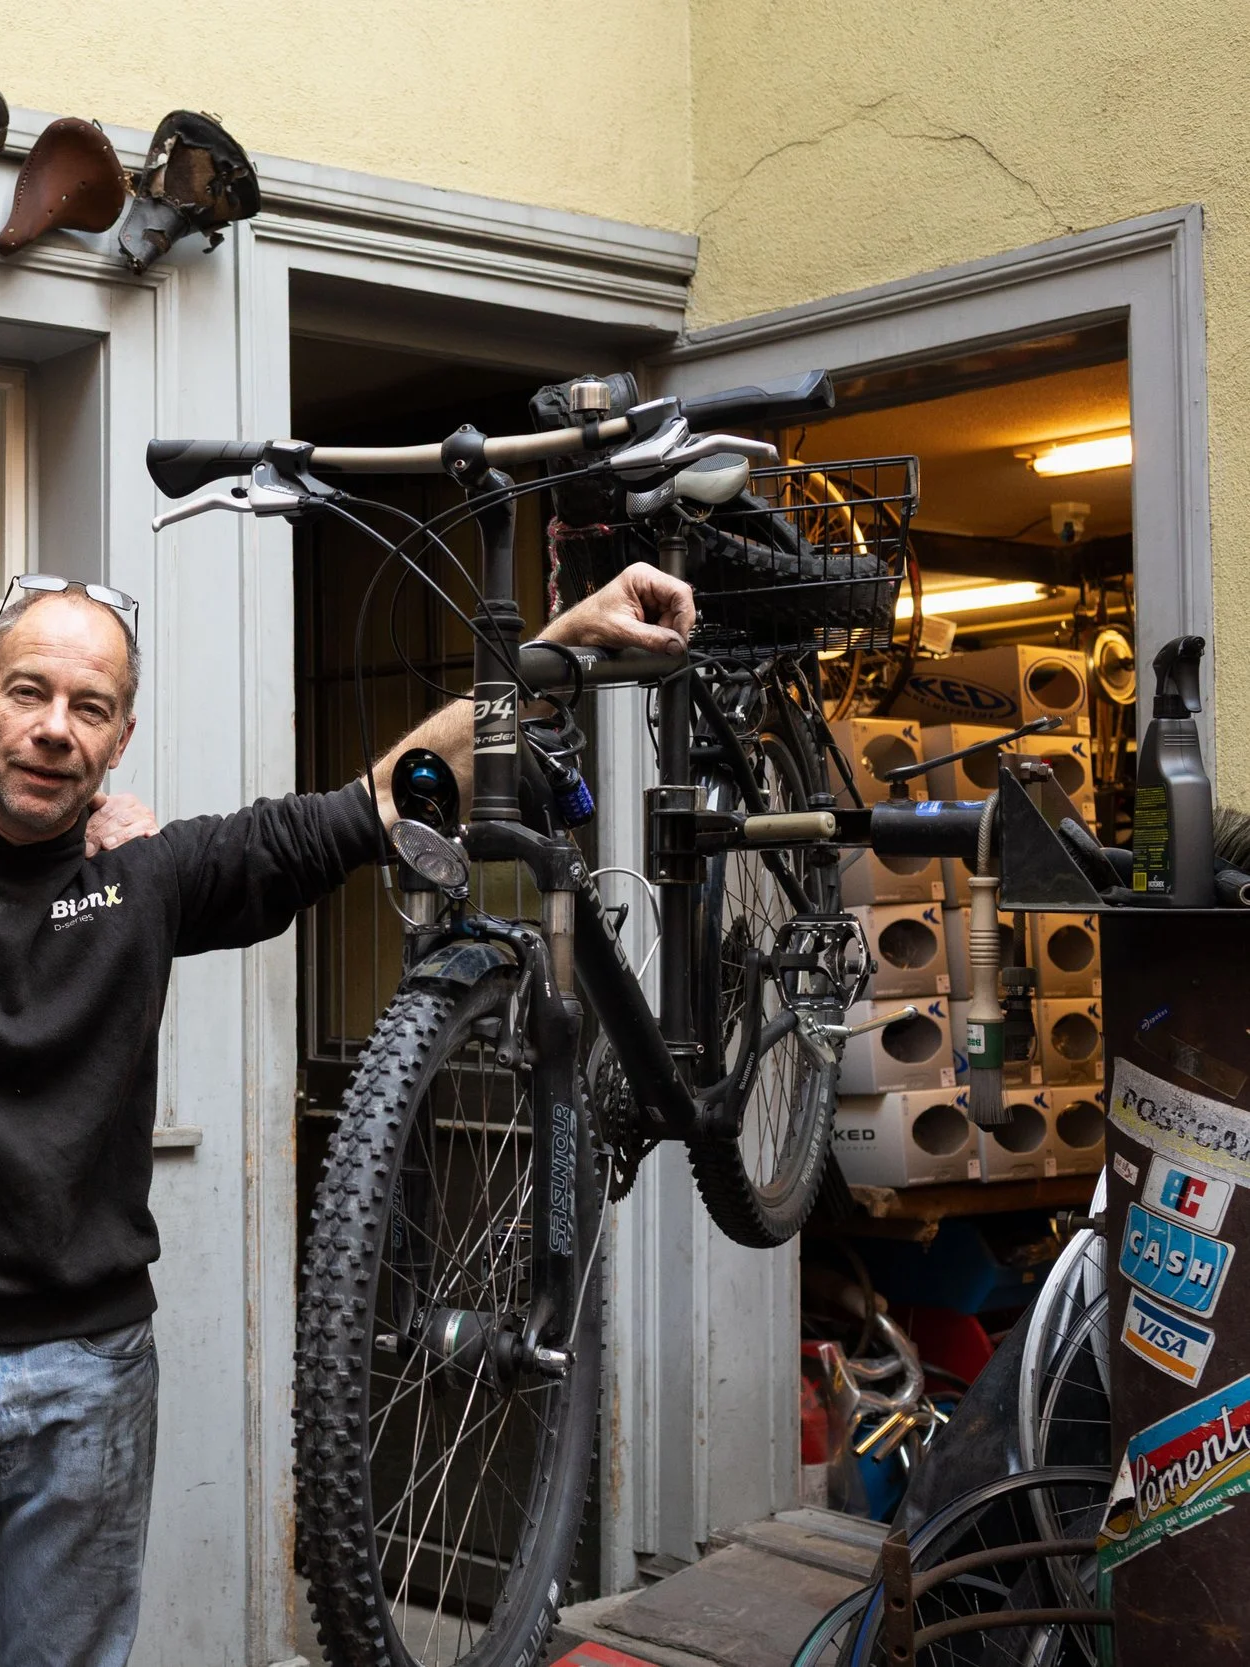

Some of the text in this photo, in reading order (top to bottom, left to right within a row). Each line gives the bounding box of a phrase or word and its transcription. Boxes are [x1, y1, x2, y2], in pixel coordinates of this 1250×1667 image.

[908, 676, 1007, 711] KED
[51, 885, 123, 919] BionX
[54, 914, 94, 931] D-series
[834, 1129, 876, 1141] KED
[550, 1103, 570, 1210] SUNTOUR
[1129, 1230, 1214, 1288] CASH
[1137, 1313, 1189, 1359] VISA
[1226, 1483, 1245, 1497] DEL
